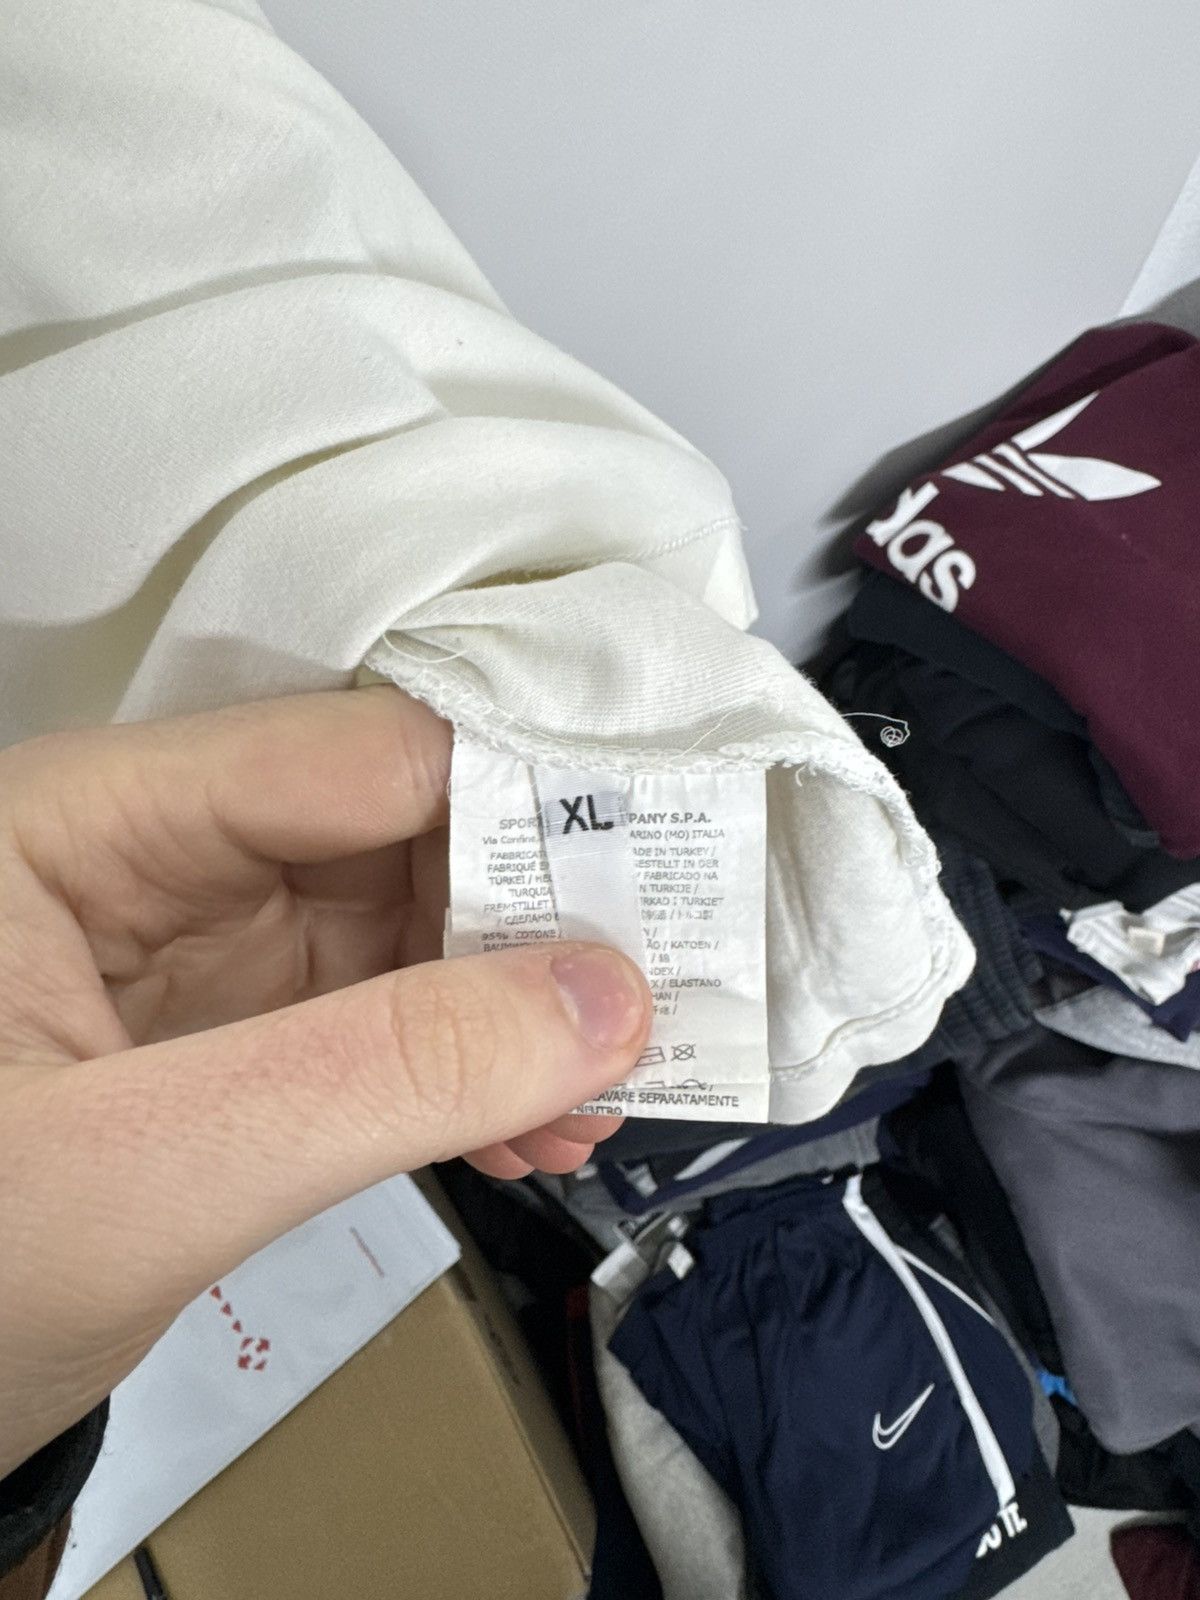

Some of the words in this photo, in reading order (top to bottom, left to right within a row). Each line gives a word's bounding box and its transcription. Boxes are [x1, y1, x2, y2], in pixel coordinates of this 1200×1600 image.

[559, 794, 614, 834] XL
[499, 817, 541, 830] SPOR
[627, 812, 667, 824] PANY
[670, 812, 712, 824] S.P.A.
[665, 830, 690, 841] (MO)
[692, 829, 725, 839] ITALIA
[654, 847, 667, 857] IN
[669, 847, 710, 856] TURKEY
[487, 860, 536, 874] FABRIQUÉ
[683, 860, 695, 869] IN
[698, 859, 720, 868] DER
[643, 872, 701, 881] FABRICADO
[703, 871, 719, 881] NA
[649, 884, 691, 893] TURKIJE
[484, 900, 549, 912] FREMSTILLET
[670, 940, 712, 950] KATOEN
[669, 978, 722, 988] ELASTANO
[638, 1091, 739, 1107] SEPARATAMENTE
